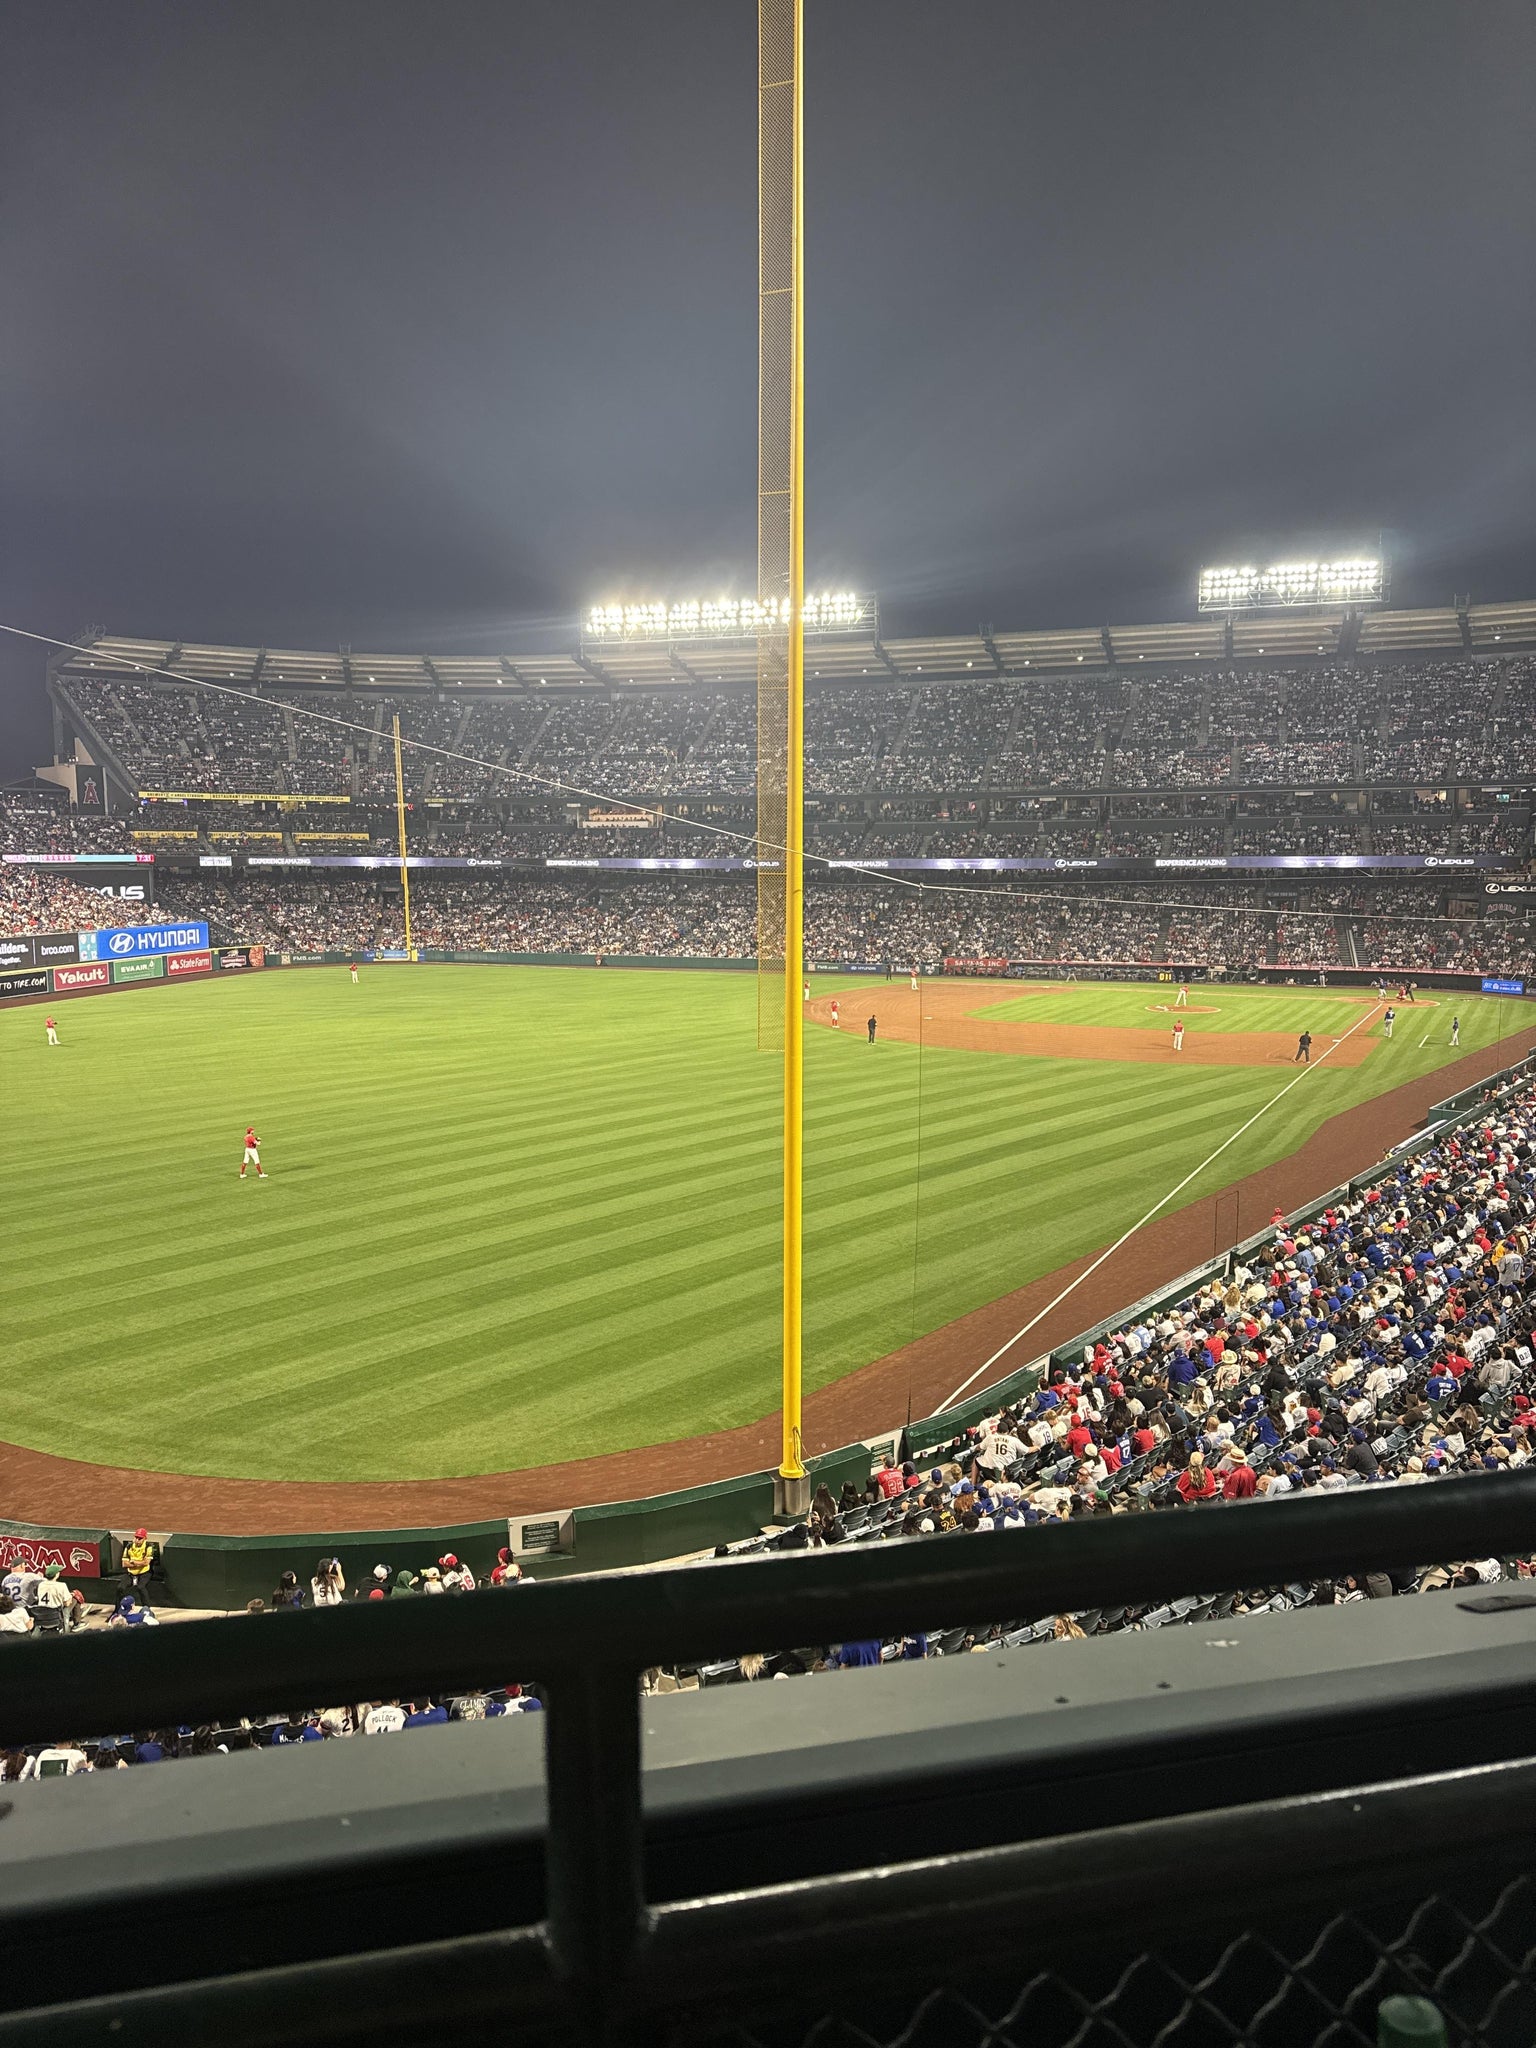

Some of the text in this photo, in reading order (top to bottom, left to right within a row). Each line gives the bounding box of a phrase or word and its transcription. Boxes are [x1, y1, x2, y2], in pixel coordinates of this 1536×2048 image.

[137, 928, 200, 950] HYUNDAI
[41, 944, 75, 956] brco.com
[58, 968, 106, 985] Yakult
[995, 1443, 1008, 1455] 16
[888, 1480, 904, 1494] 22
[0, 1539, 66, 1573] ARM
[41, 1592, 50, 1605] 4
[371, 1714, 397, 1724] POLLOCK
